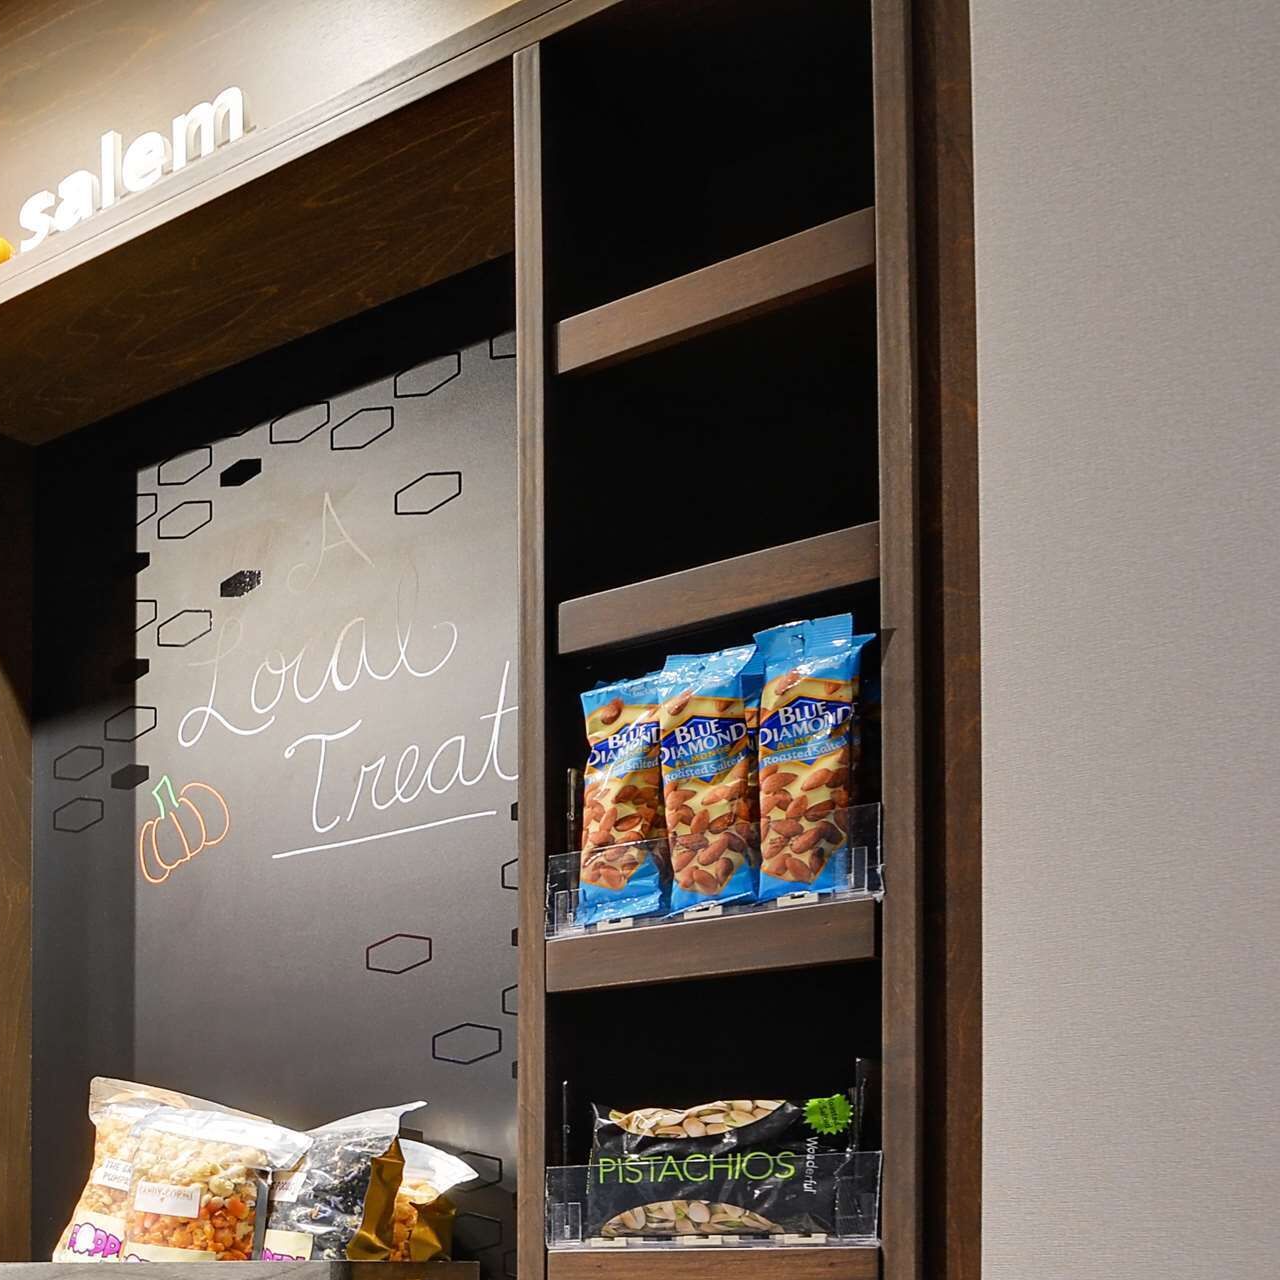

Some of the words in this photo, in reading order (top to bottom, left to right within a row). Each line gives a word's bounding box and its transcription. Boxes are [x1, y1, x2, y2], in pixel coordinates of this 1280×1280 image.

[19, 86, 251, 252] salem
[287, 492, 374, 594] A
[178, 562, 458, 748] Local
[675, 718, 720, 745] BLUE
[759, 705, 855, 746] DIAMOND
[779, 701, 827, 727] BLUE
[659, 722, 747, 765] DIAMOND
[763, 748, 811, 766] Roasted
[812, 738, 849, 757] Salted
[598, 1152, 795, 1185] PISTACHIOS
[803, 1137, 819, 1195] Wonderful
